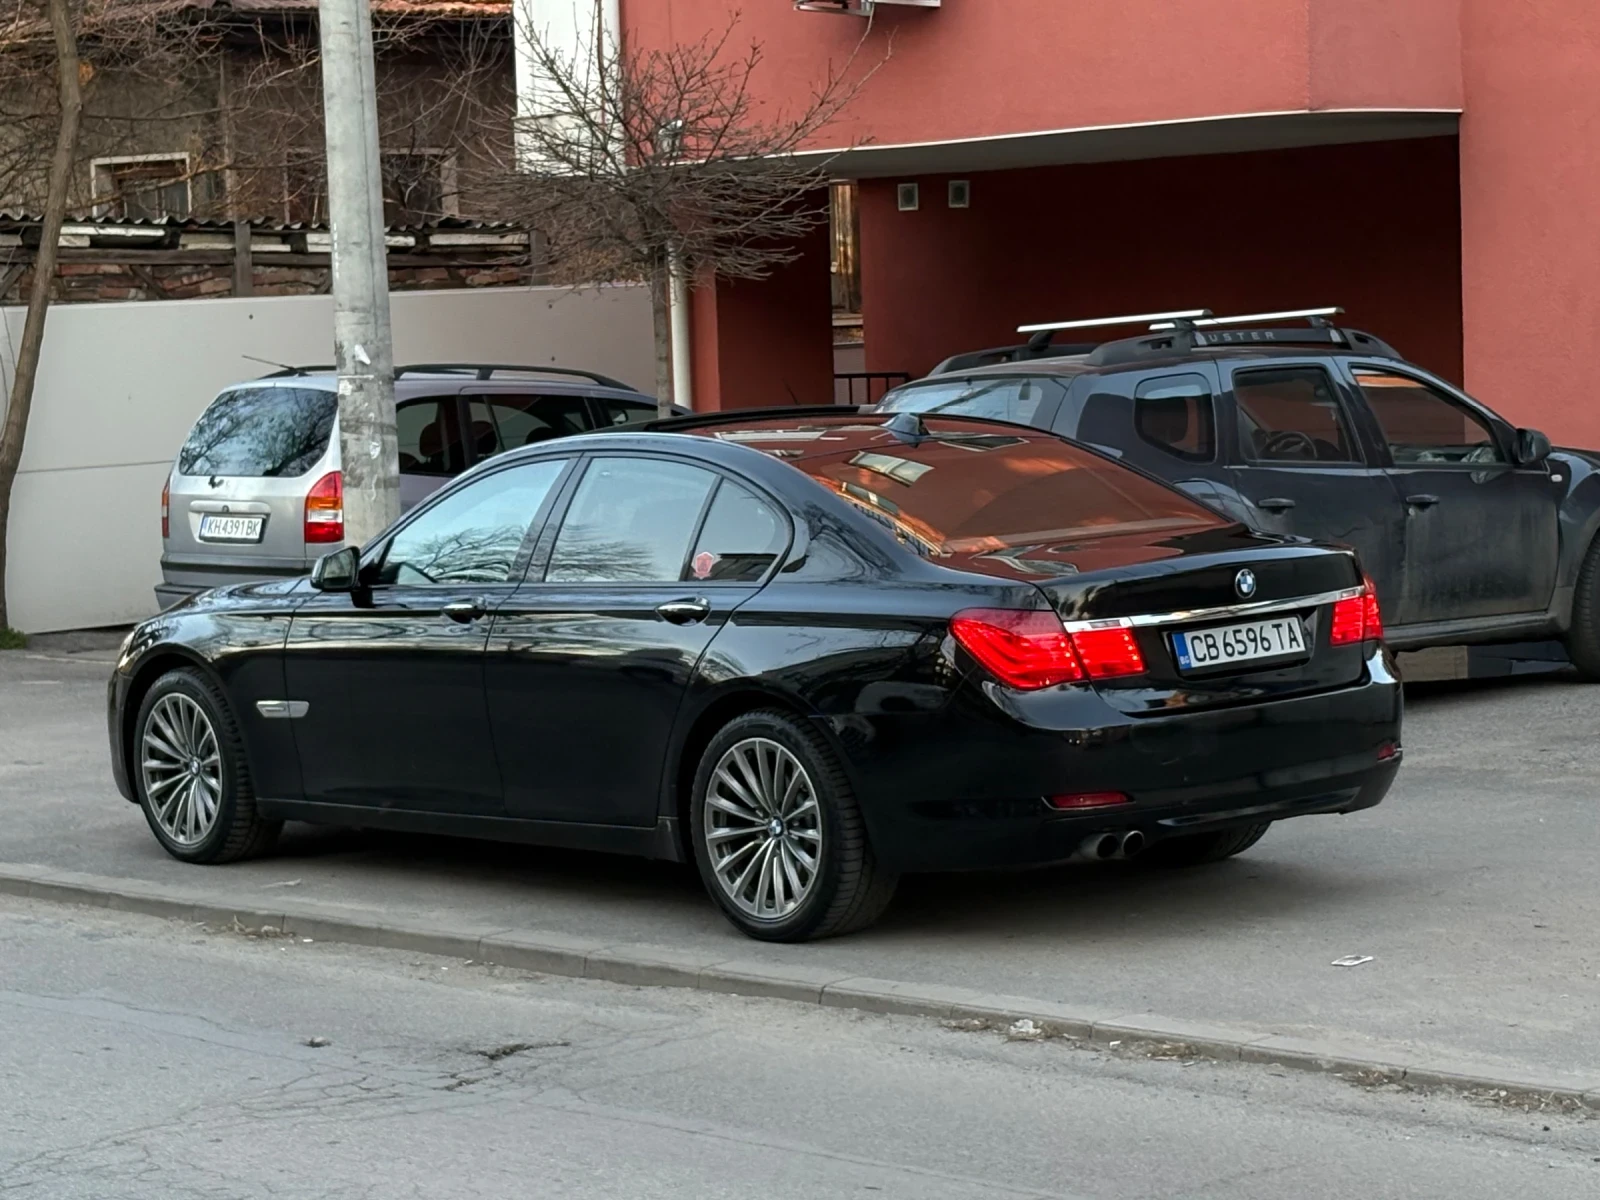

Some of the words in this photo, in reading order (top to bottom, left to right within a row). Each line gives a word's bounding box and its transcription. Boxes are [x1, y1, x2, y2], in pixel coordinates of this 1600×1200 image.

[1208, 331, 1276, 342] USTER
[222, 519, 246, 536] 4391
[1190, 633, 1220, 662] CB
[1223, 626, 1271, 658] 6596
[1271, 622, 1300, 650] TA
